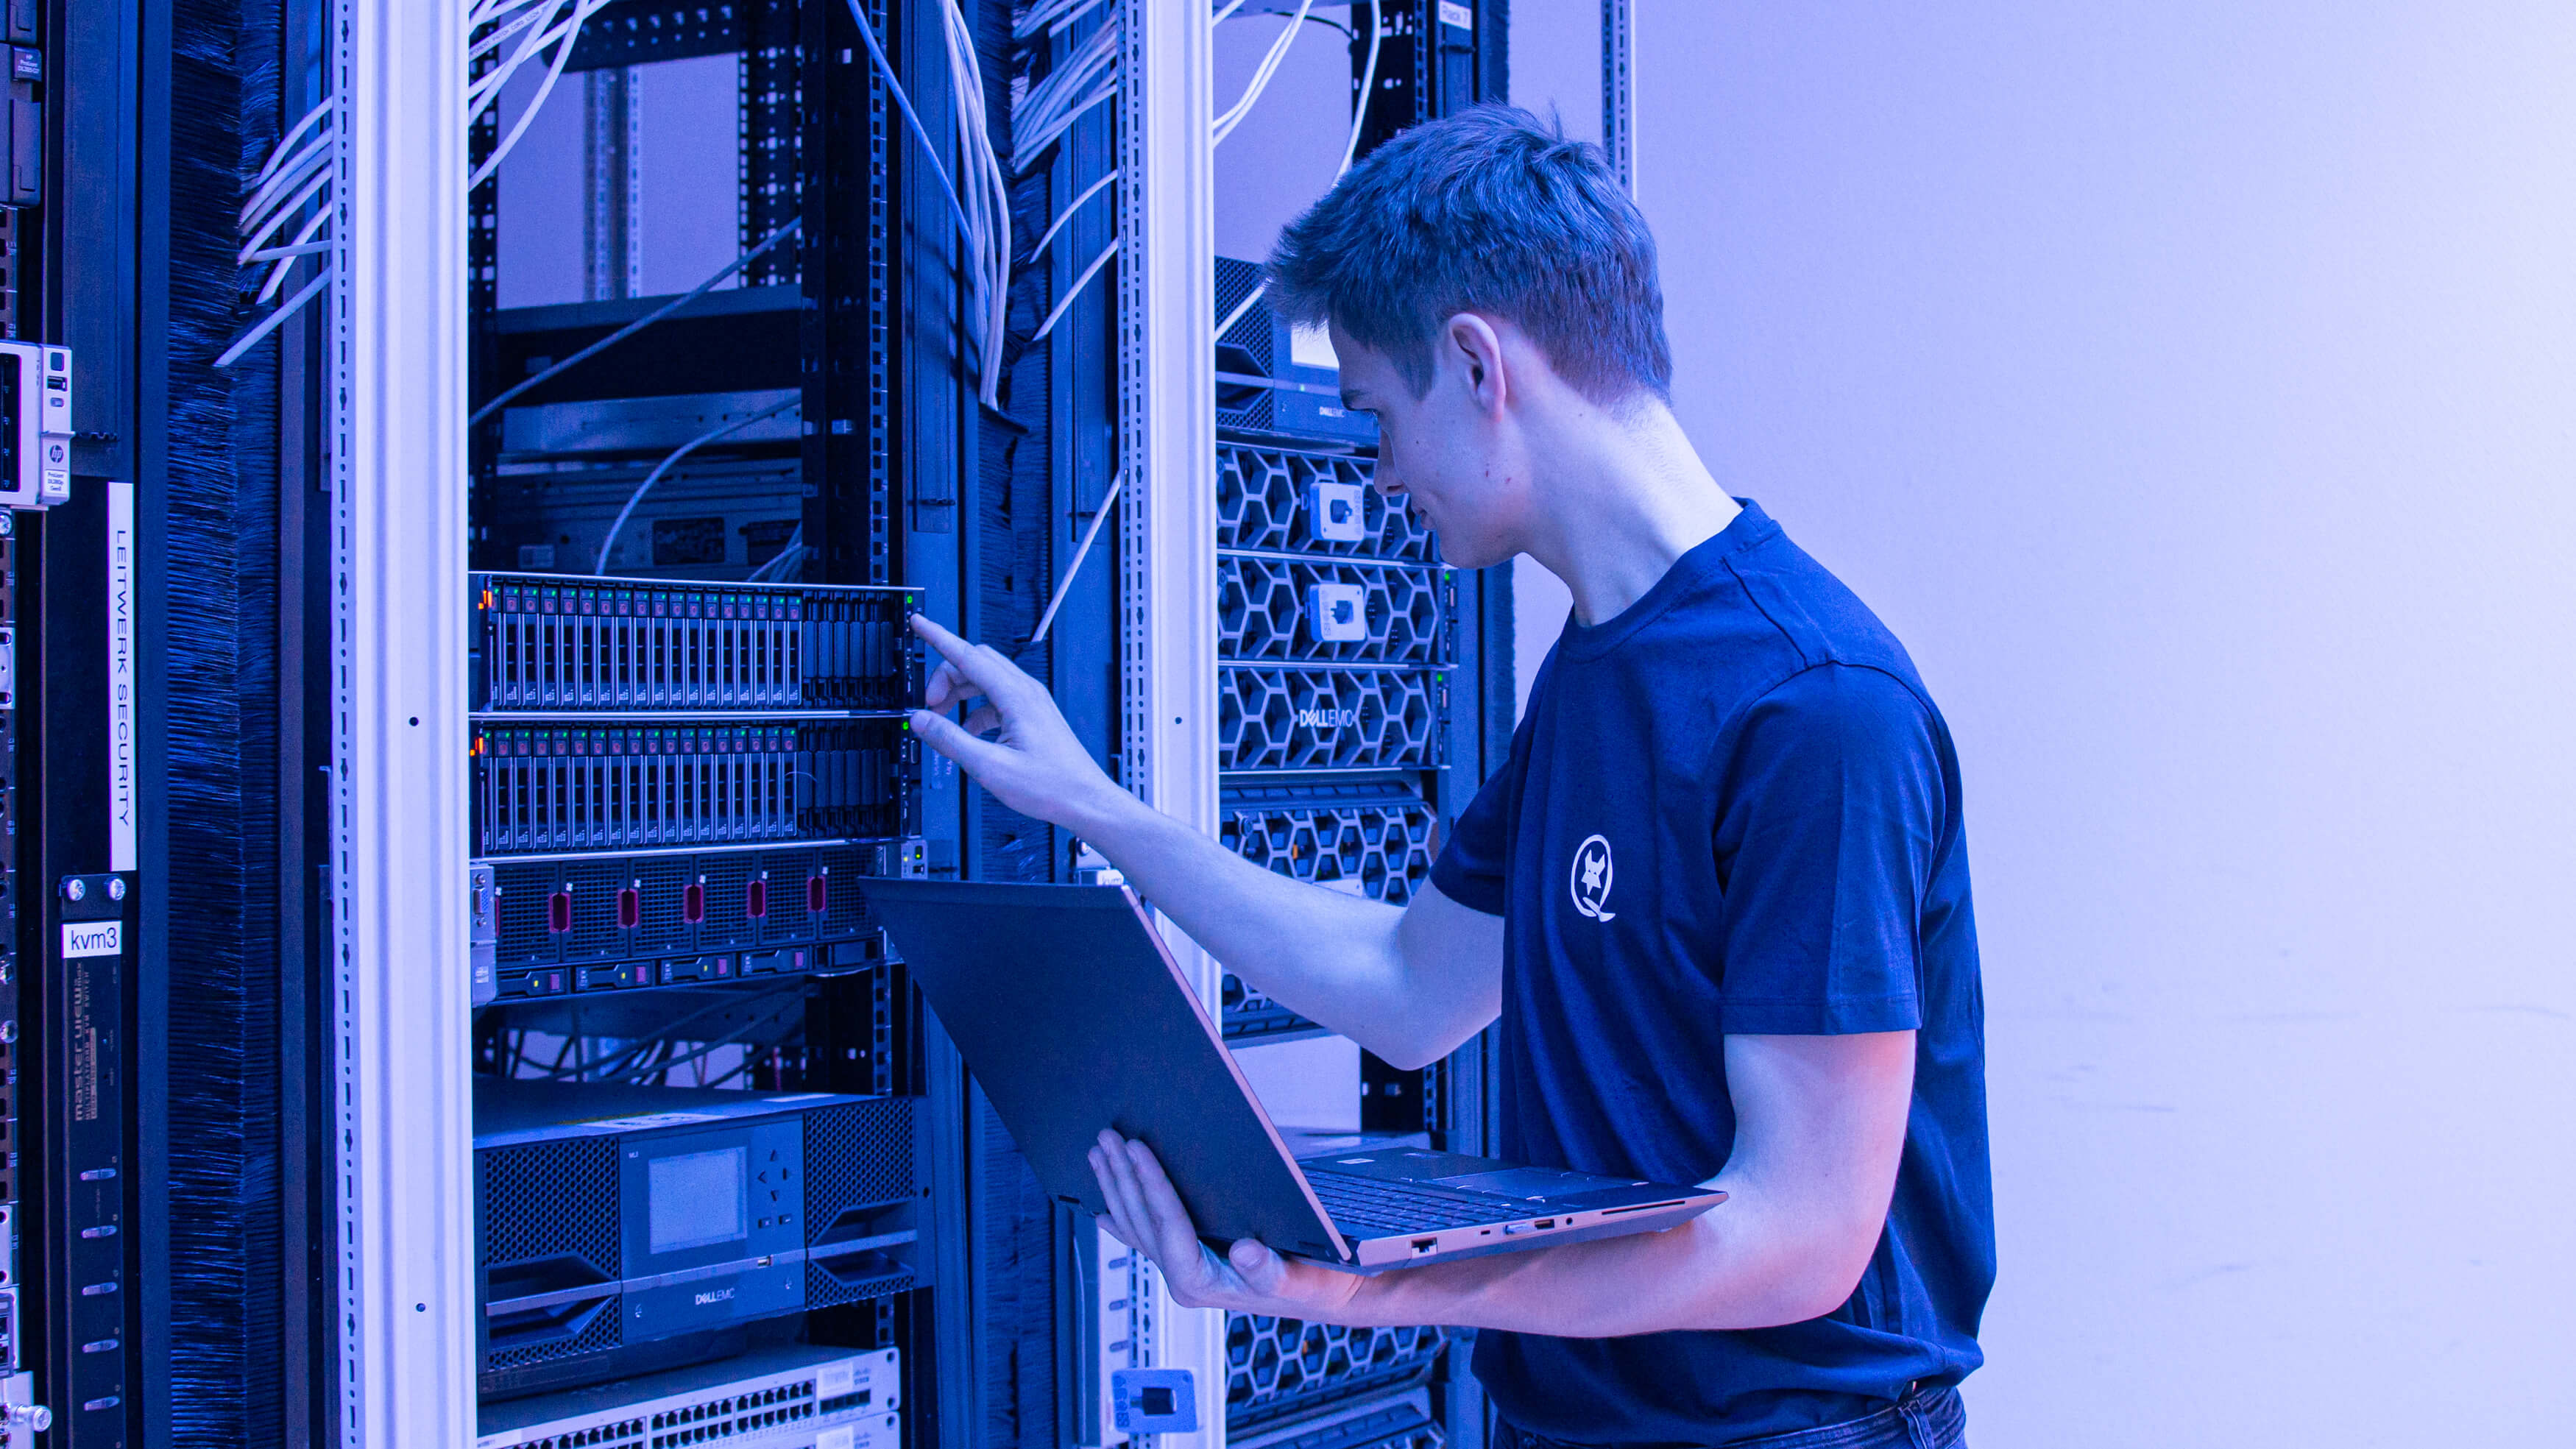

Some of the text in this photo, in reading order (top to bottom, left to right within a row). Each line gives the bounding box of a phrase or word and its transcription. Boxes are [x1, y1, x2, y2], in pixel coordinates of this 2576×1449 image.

[116, 530, 130, 826] LEITWERK SECURITY
[71, 927, 117, 951] kvm3
